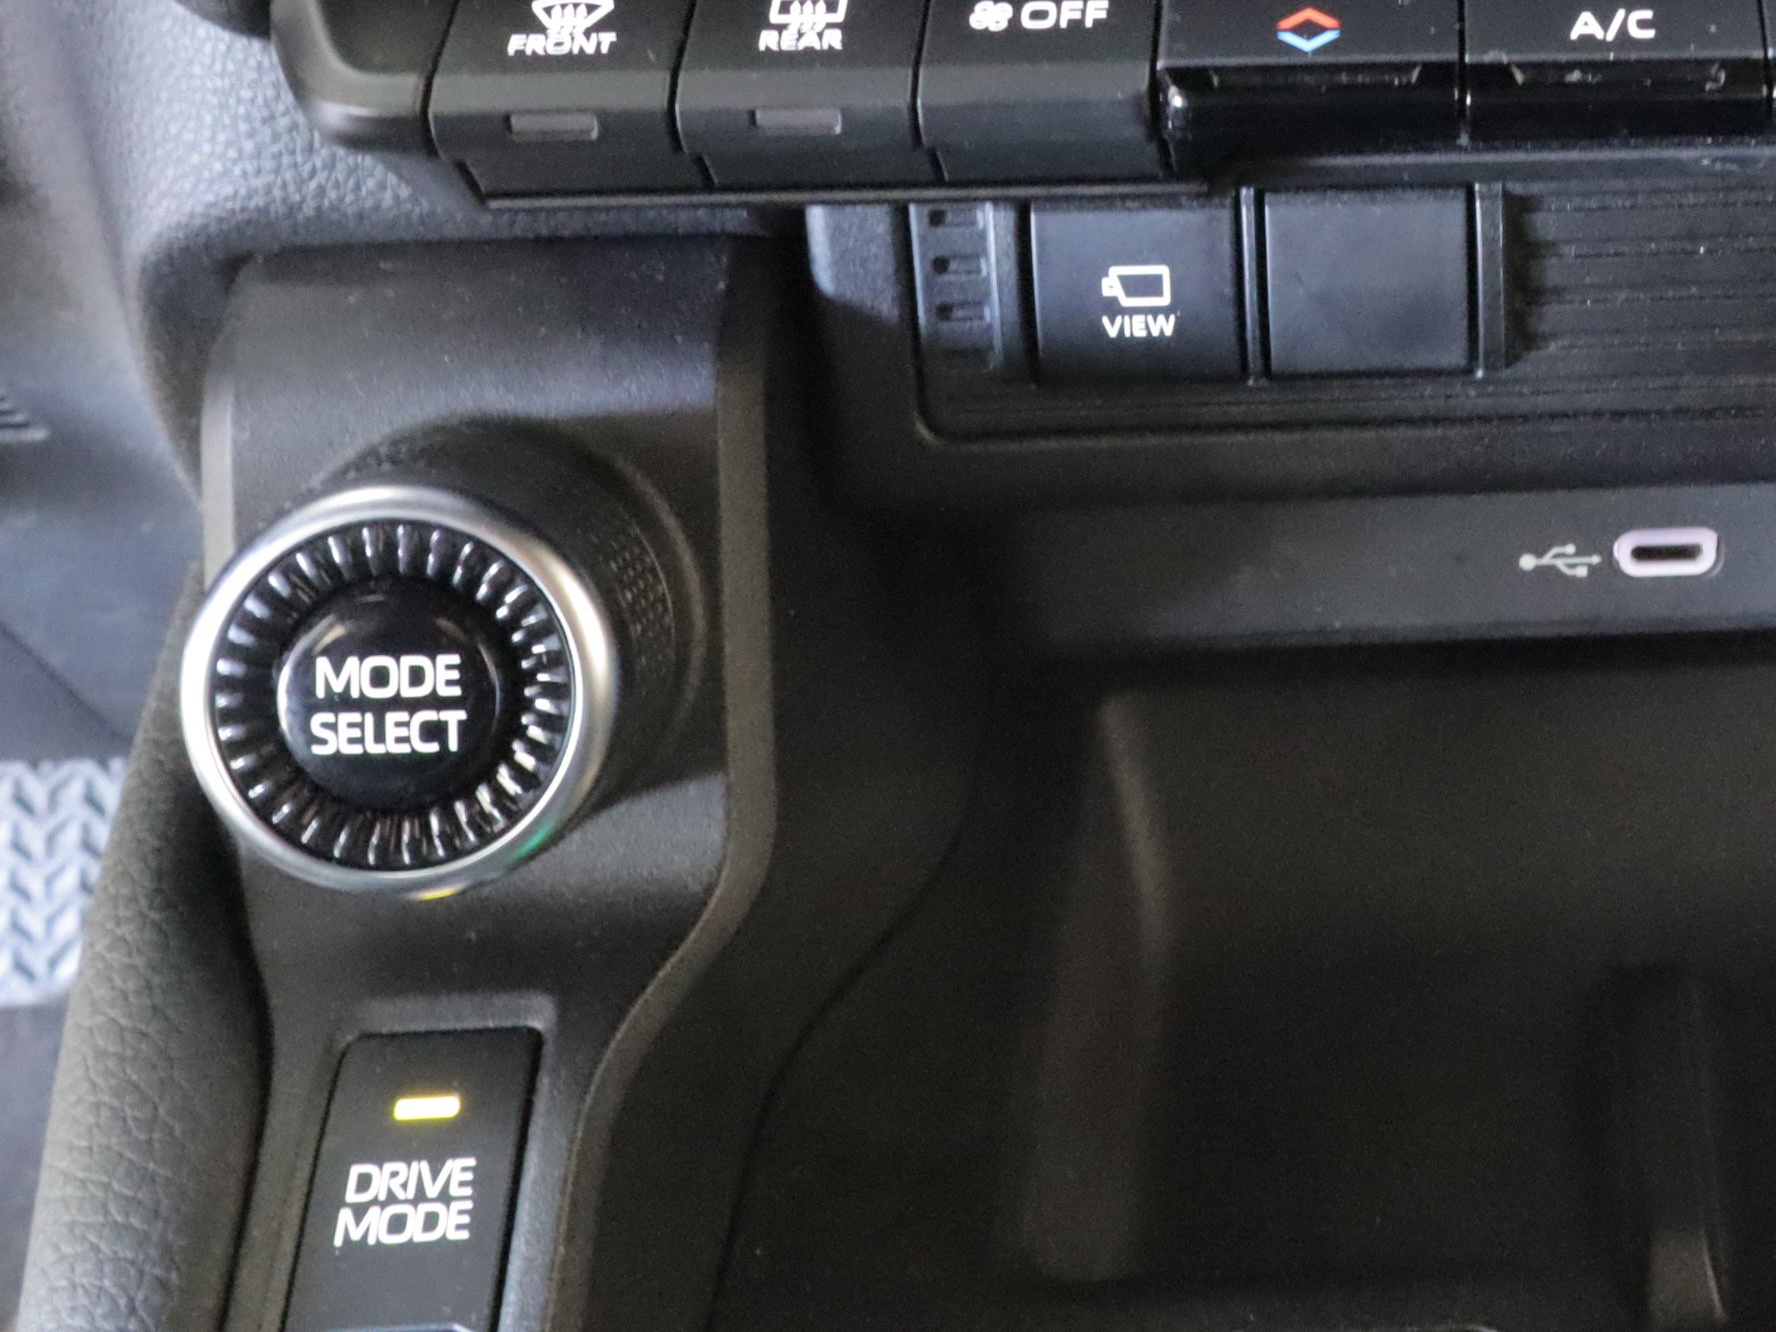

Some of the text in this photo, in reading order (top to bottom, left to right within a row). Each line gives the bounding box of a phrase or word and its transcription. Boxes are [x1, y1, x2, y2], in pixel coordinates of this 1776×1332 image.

[506, 31, 618, 57] FRONT
[757, 27, 844, 53] REAR
[1569, 8, 1657, 42] A/C
[1101, 310, 1176, 339] VIEW
[313, 653, 463, 700] MODE
[310, 709, 468, 756] SELECT
[344, 1156, 477, 1204] DRIVE
[332, 1198, 475, 1248] MODE
